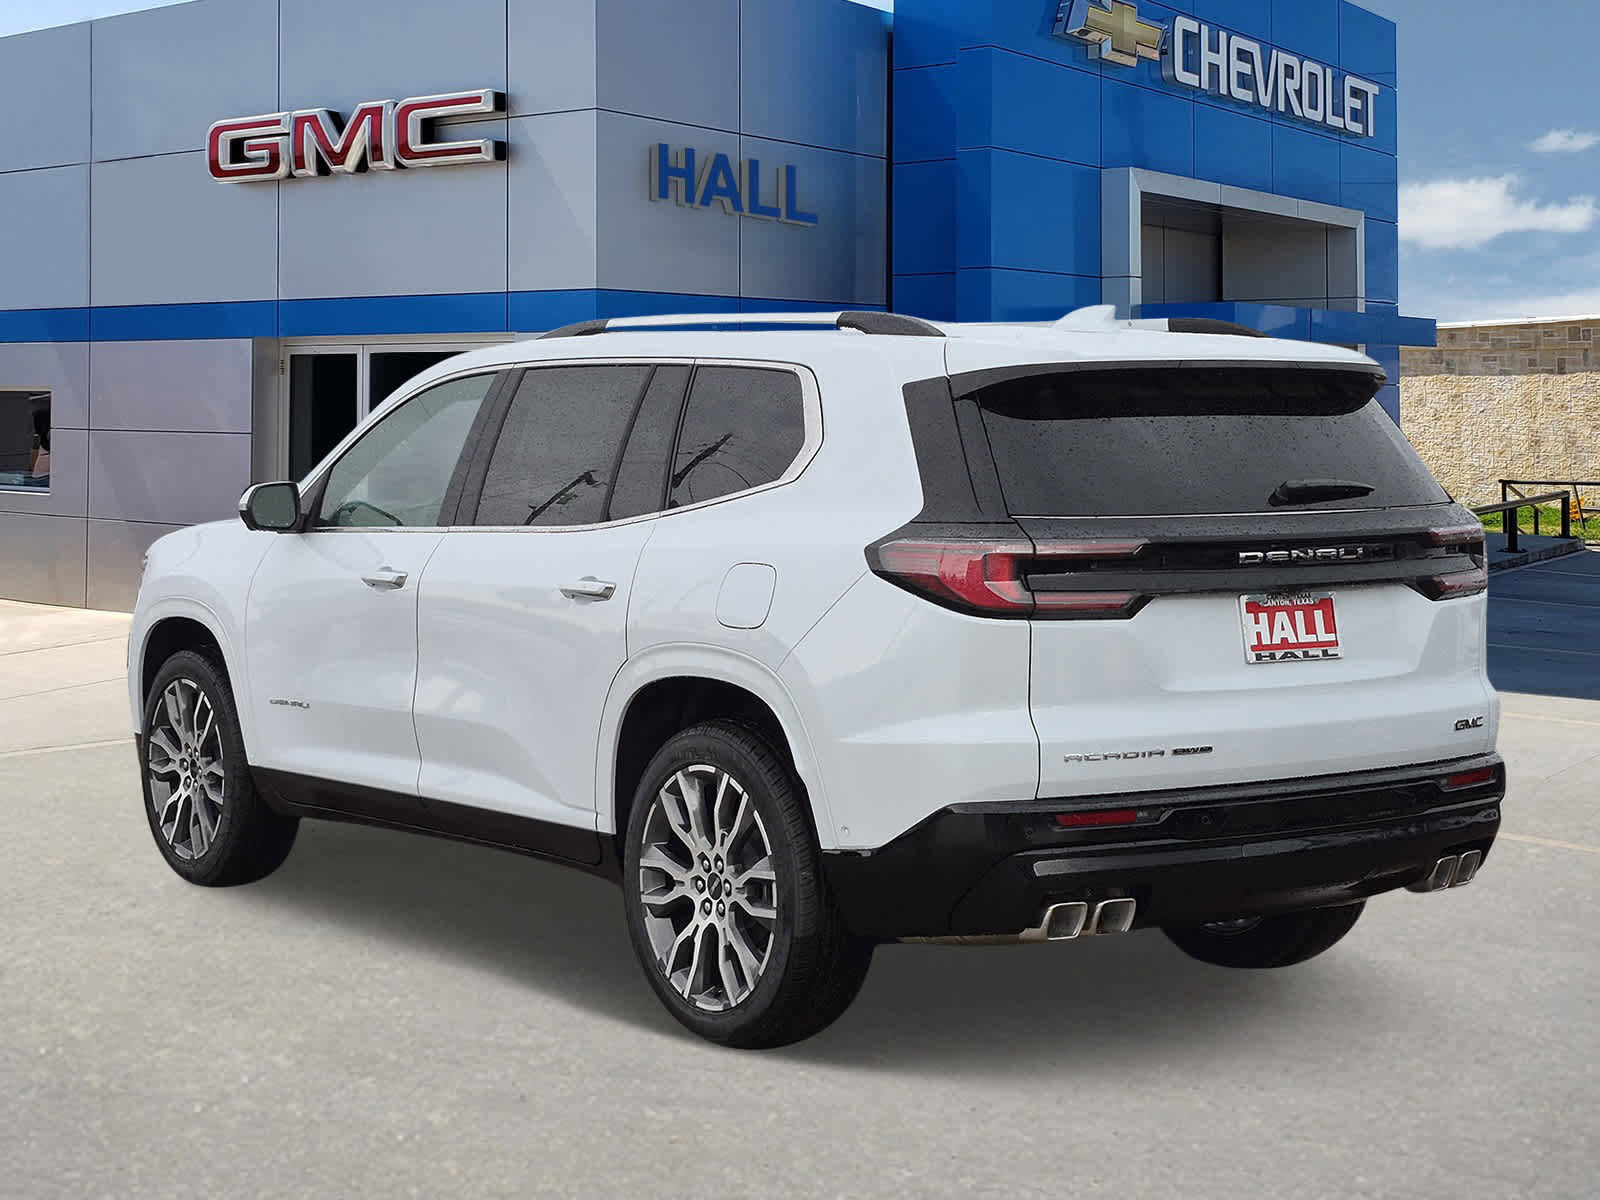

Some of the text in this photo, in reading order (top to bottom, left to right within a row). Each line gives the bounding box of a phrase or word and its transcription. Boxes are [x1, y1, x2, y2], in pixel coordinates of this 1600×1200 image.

[1174, 15, 1379, 137] CHEVROLET
[206, 88, 503, 184] GMC
[655, 142, 818, 226] HALL
[1239, 547, 1364, 564] DENALI
[1246, 609, 1337, 645] HALL
[1255, 649, 1338, 661] HALL
[1455, 716, 1483, 731] GMC
[1063, 749, 1166, 762] ACADIA
